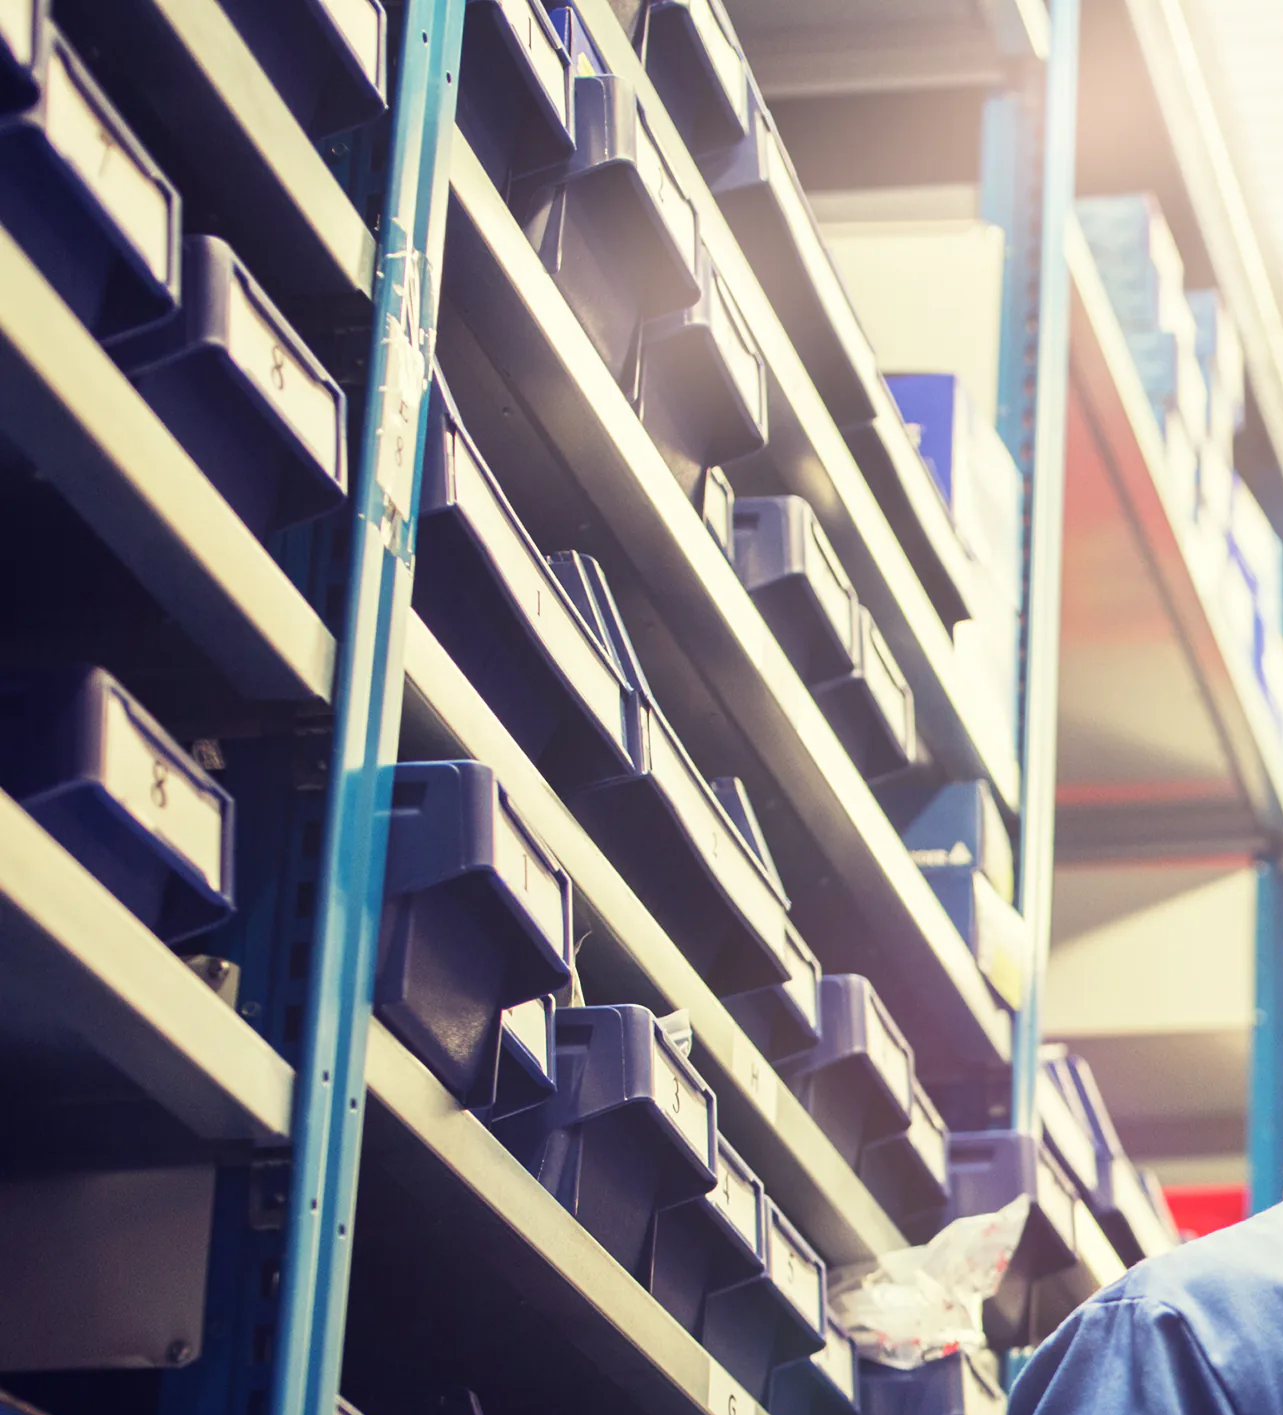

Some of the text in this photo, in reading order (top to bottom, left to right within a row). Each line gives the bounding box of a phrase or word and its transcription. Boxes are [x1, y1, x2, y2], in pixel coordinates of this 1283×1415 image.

[271, 344, 285, 392] 8
[150, 760, 167, 808] 8
[672, 1076, 680, 1114] 3
